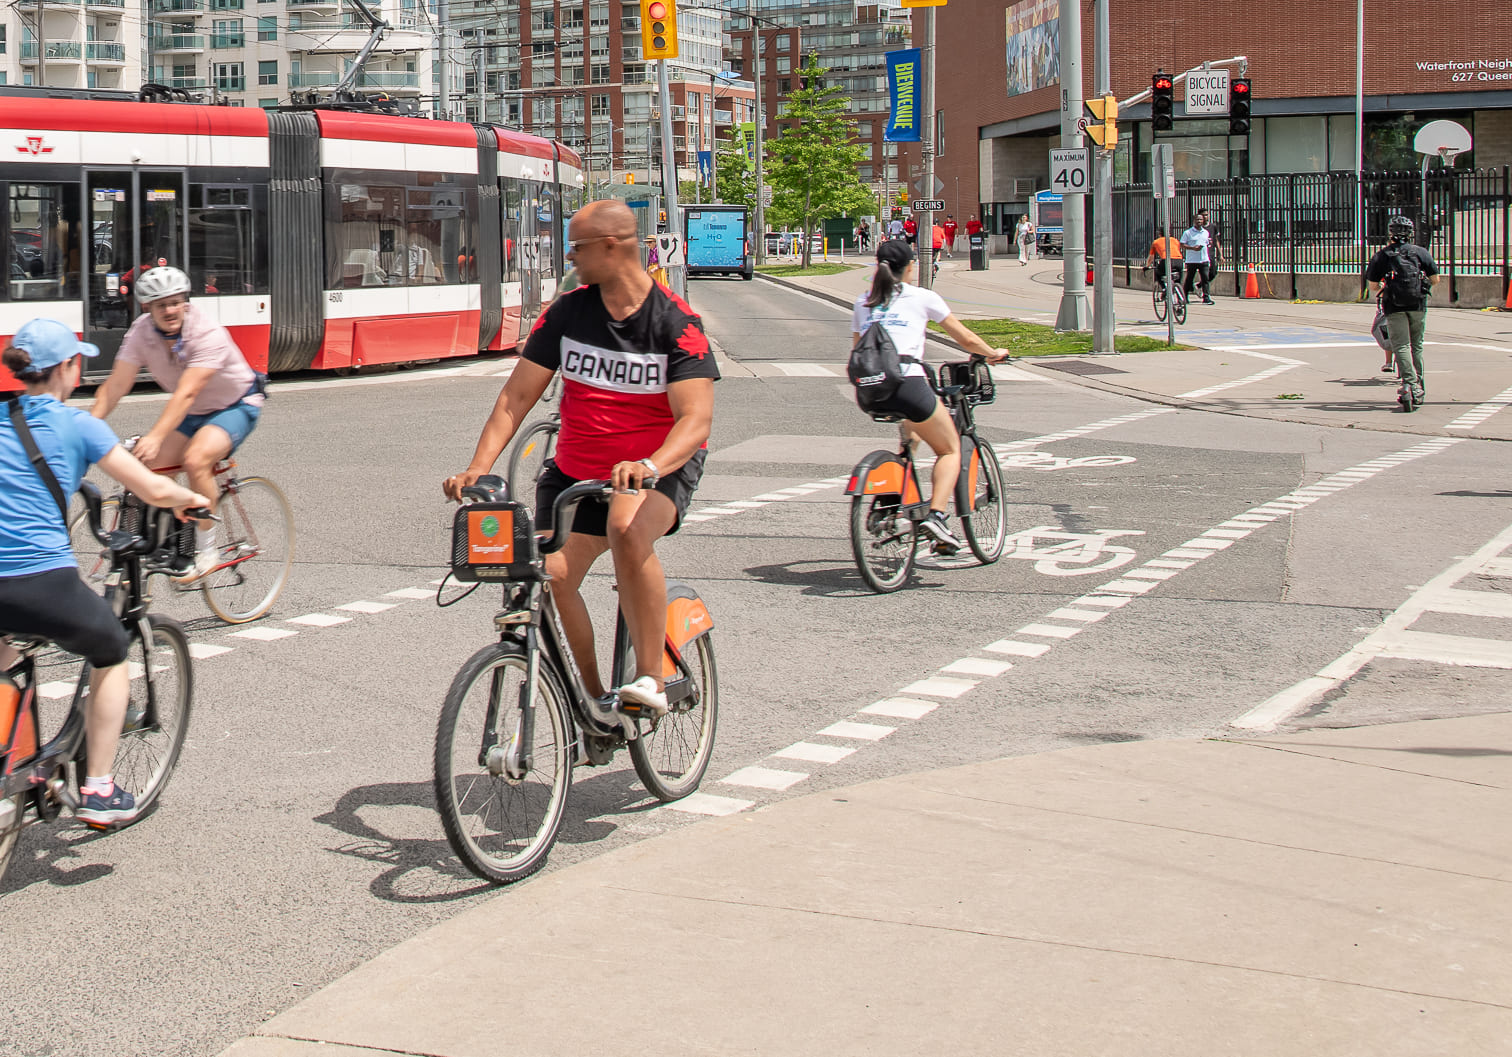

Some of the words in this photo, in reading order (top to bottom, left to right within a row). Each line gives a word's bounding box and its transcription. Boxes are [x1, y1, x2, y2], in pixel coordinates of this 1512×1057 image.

[1416, 59, 1475, 71] Waterfront
[1189, 76, 1227, 90] BICYCLE
[1451, 72, 1474, 82] 627
[893, 61, 915, 130] BIENVENUE
[1190, 93, 1225, 107] SIGNAL
[1053, 153, 1085, 162] MAXIMUM
[1053, 167, 1085, 188] 40
[915, 201, 942, 210] BEGINS
[565, 350, 661, 386] CANADA
